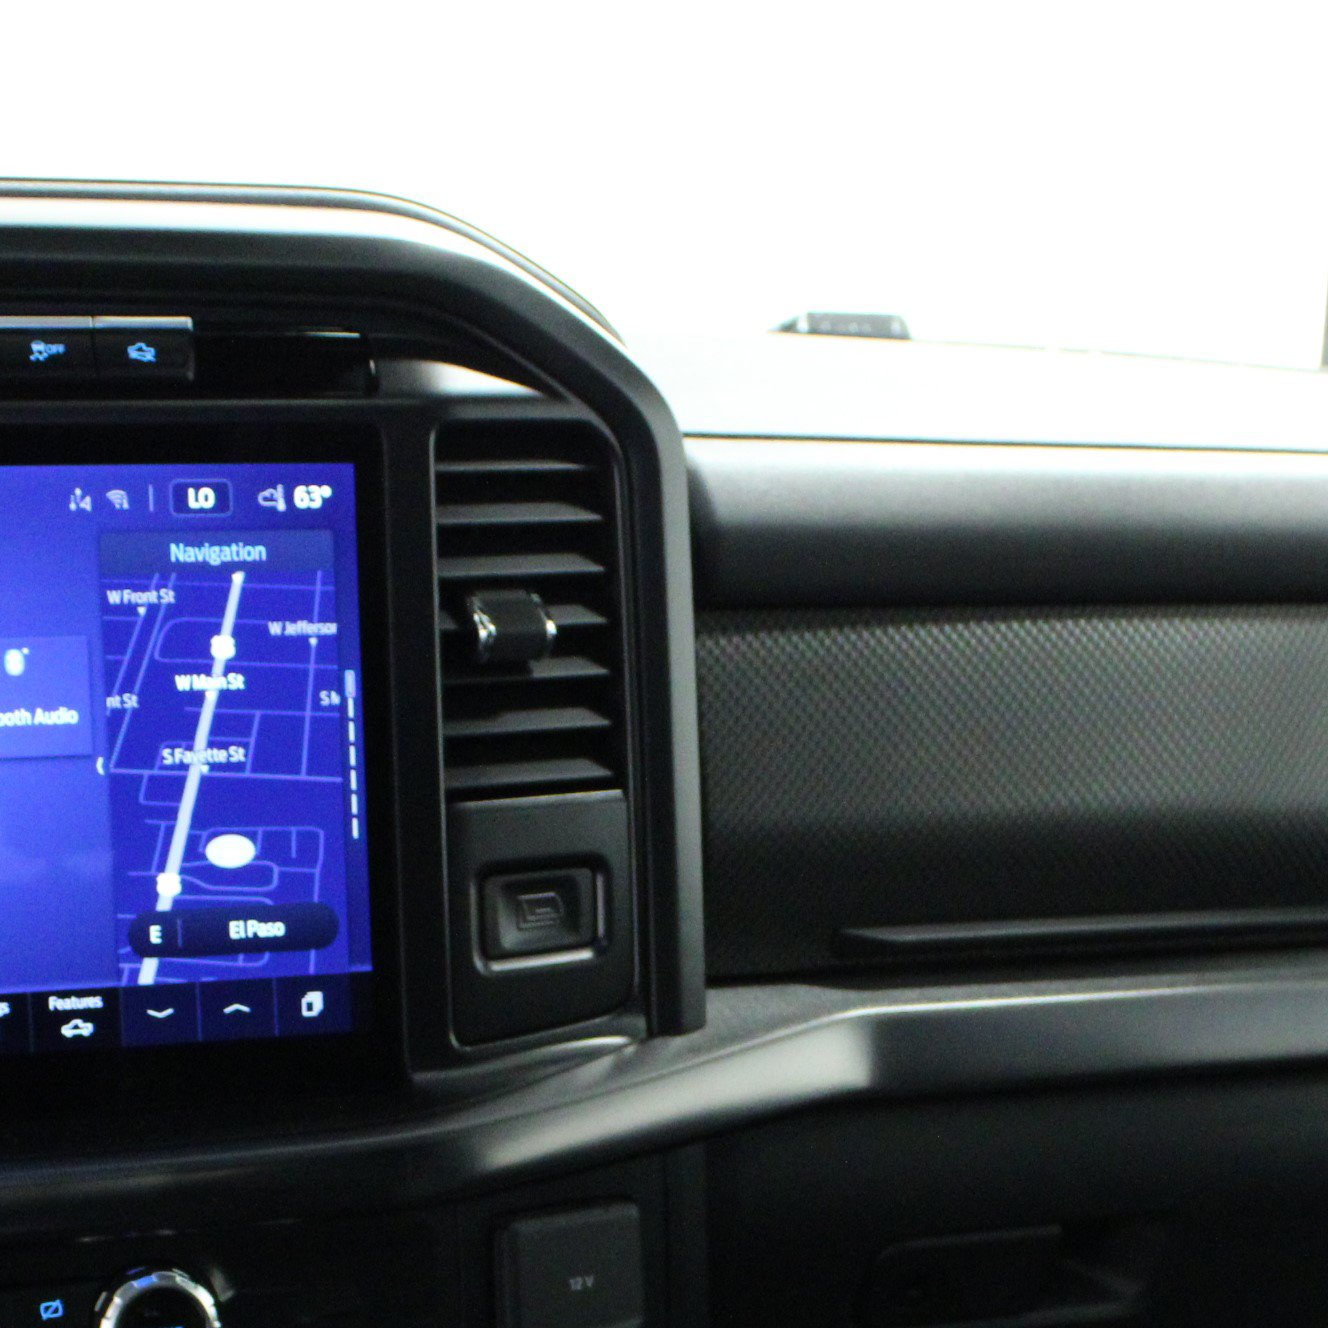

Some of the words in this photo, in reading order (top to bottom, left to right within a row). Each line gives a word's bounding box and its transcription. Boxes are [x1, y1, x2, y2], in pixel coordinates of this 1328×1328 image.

[187, 487, 216, 509] LO
[169, 542, 267, 565] Navigation
[106, 589, 121, 605] W
[122, 588, 158, 605] Front
[159, 587, 176, 605] St
[175, 674, 191, 691] W
[228, 673, 245, 690] St
[122, 692, 140, 709] St
[33, 706, 79, 726] Audio
[162, 748, 174, 765] S
[175, 747, 228, 767] Fayette
[228, 745, 246, 764] St
[149, 924, 162, 944] E
[228, 920, 245, 940] El
[246, 919, 286, 940] Paso
[47, 994, 104, 1012] Features
